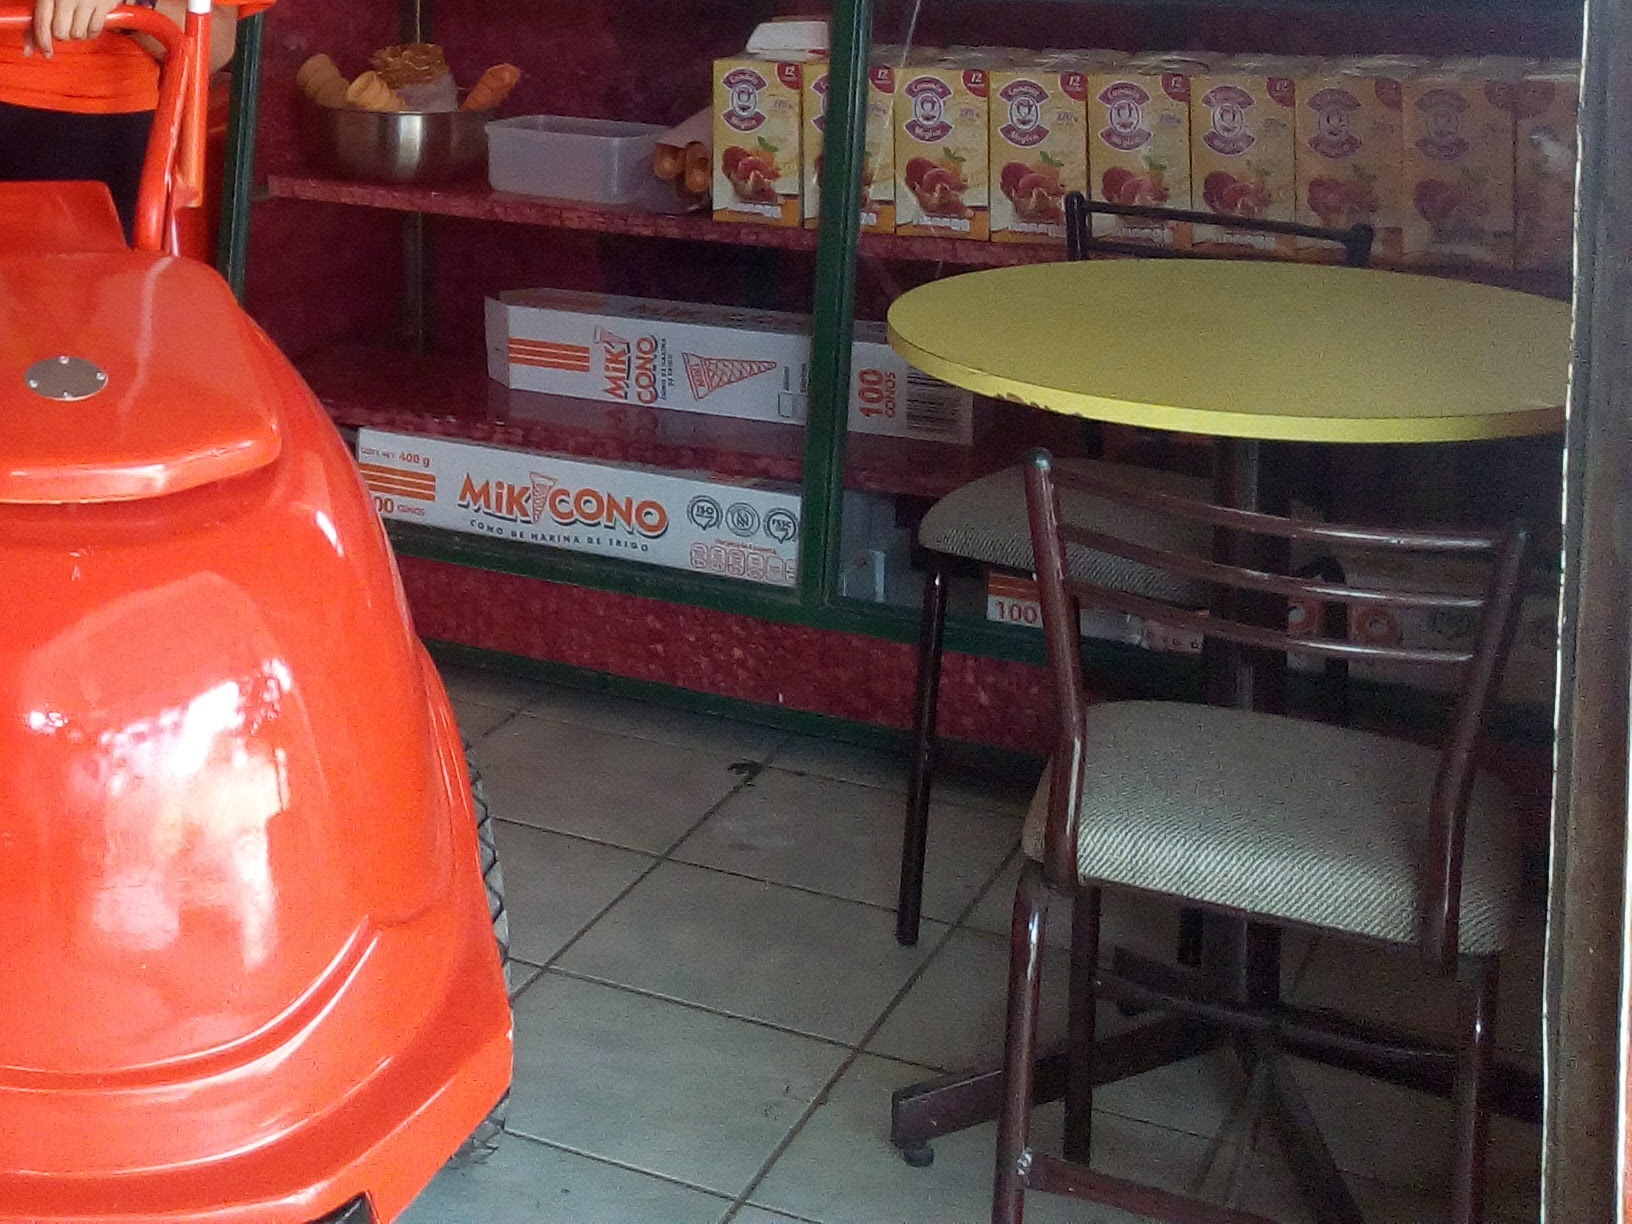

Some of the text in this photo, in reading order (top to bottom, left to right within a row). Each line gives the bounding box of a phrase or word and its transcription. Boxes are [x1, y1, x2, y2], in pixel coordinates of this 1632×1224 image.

[635, 335, 658, 404] CONO
[859, 368, 886, 417] 100
[399, 451, 421, 465] 400
[422, 455, 430, 468] g
[373, 496, 395, 515] 00
[510, 529, 525, 539] DE
[531, 532, 580, 545] HARINA
[587, 536, 601, 546] DE
[996, 600, 1038, 624] 100
